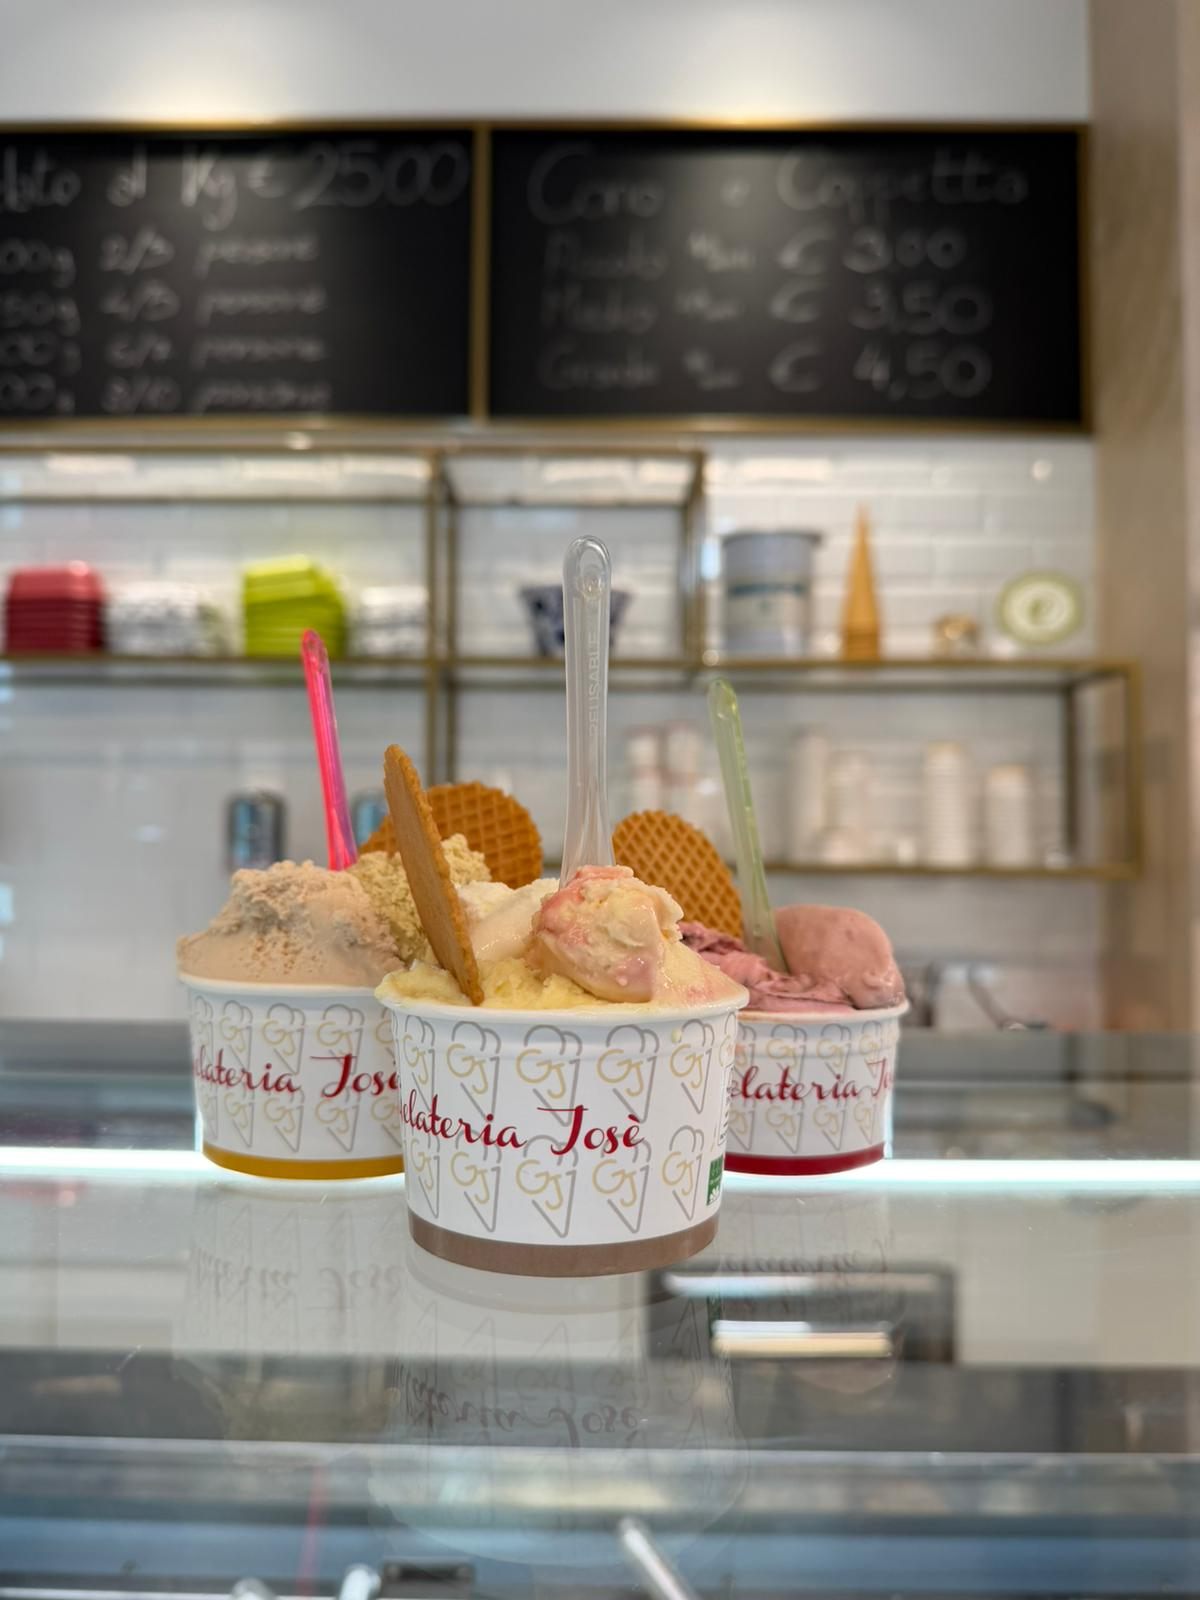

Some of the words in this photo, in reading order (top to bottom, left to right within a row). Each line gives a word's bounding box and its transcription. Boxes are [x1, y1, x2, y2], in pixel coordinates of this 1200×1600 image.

[853, 339, 992, 401] 4,50
[588, 632, 602, 738] REUSABLE
[537, 1104, 645, 1155] Josè
